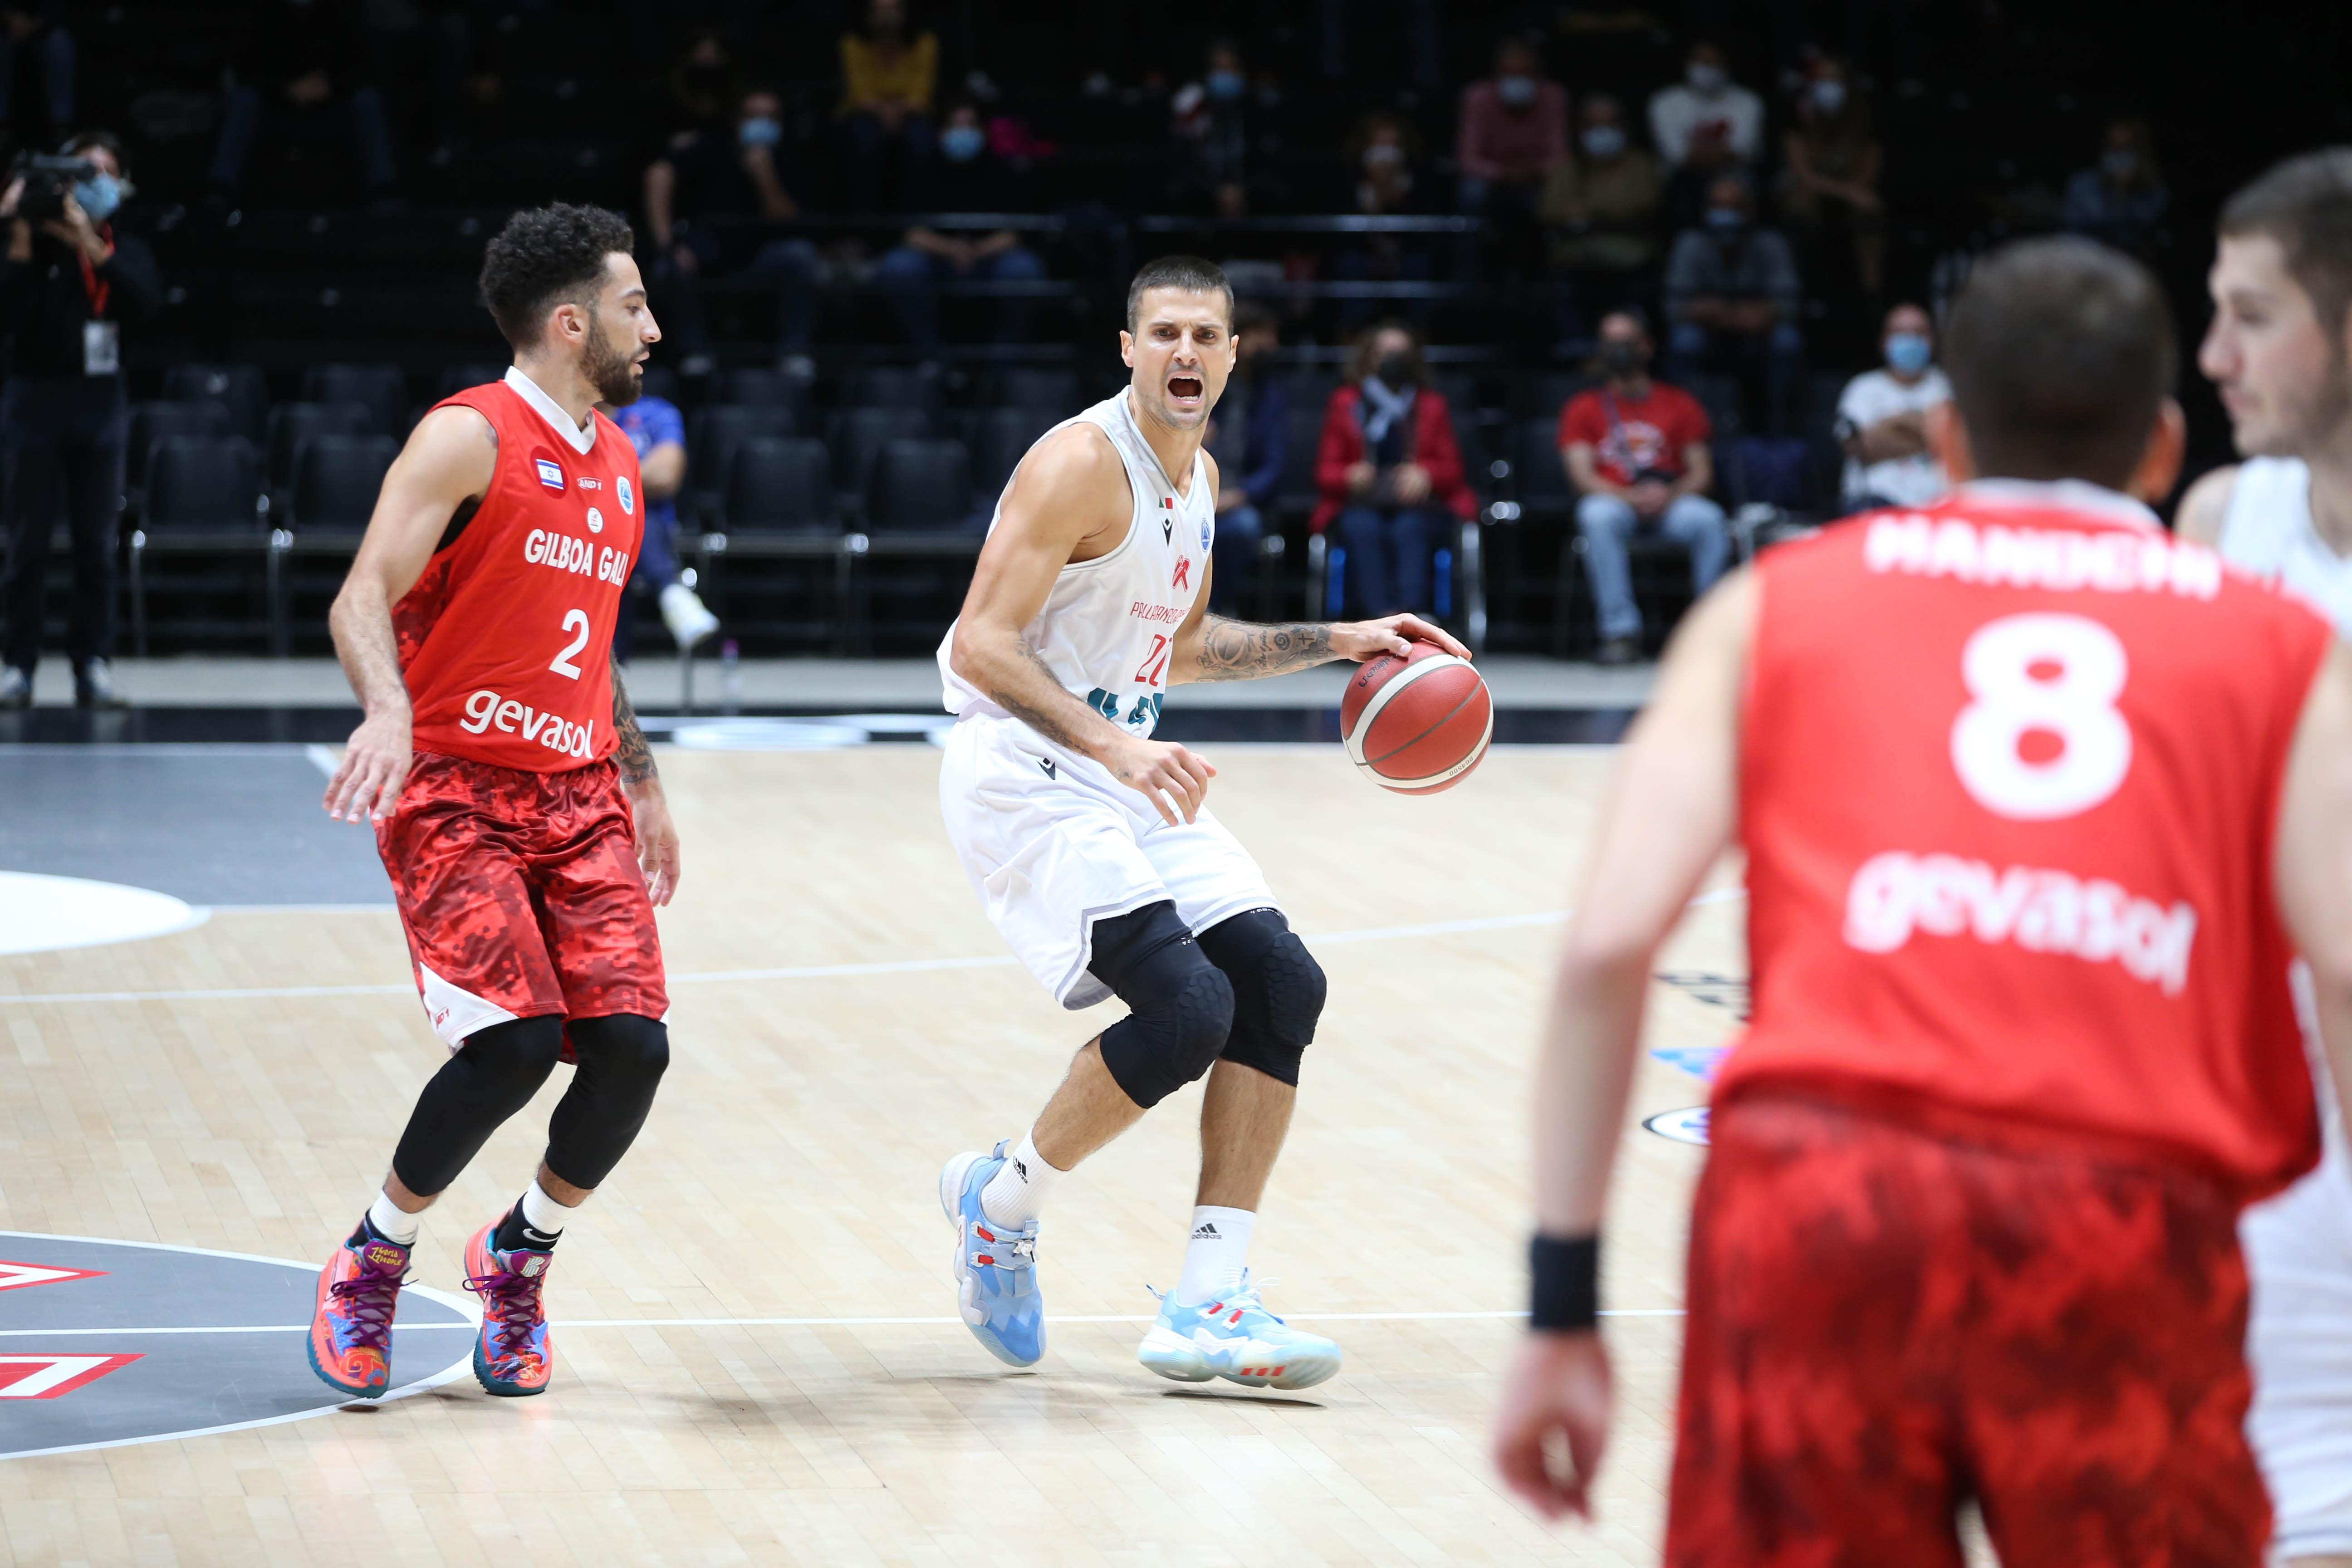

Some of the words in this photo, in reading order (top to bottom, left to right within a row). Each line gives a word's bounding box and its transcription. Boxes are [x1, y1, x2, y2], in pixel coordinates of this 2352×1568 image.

[525, 529, 593, 577] GILBOA
[549, 609, 589, 680] 2
[1358, 653, 1399, 688] olten
[460, 690, 594, 760] gevasol
[1951, 613, 2131, 818] 8
[1846, 853, 2195, 993] gevasol
